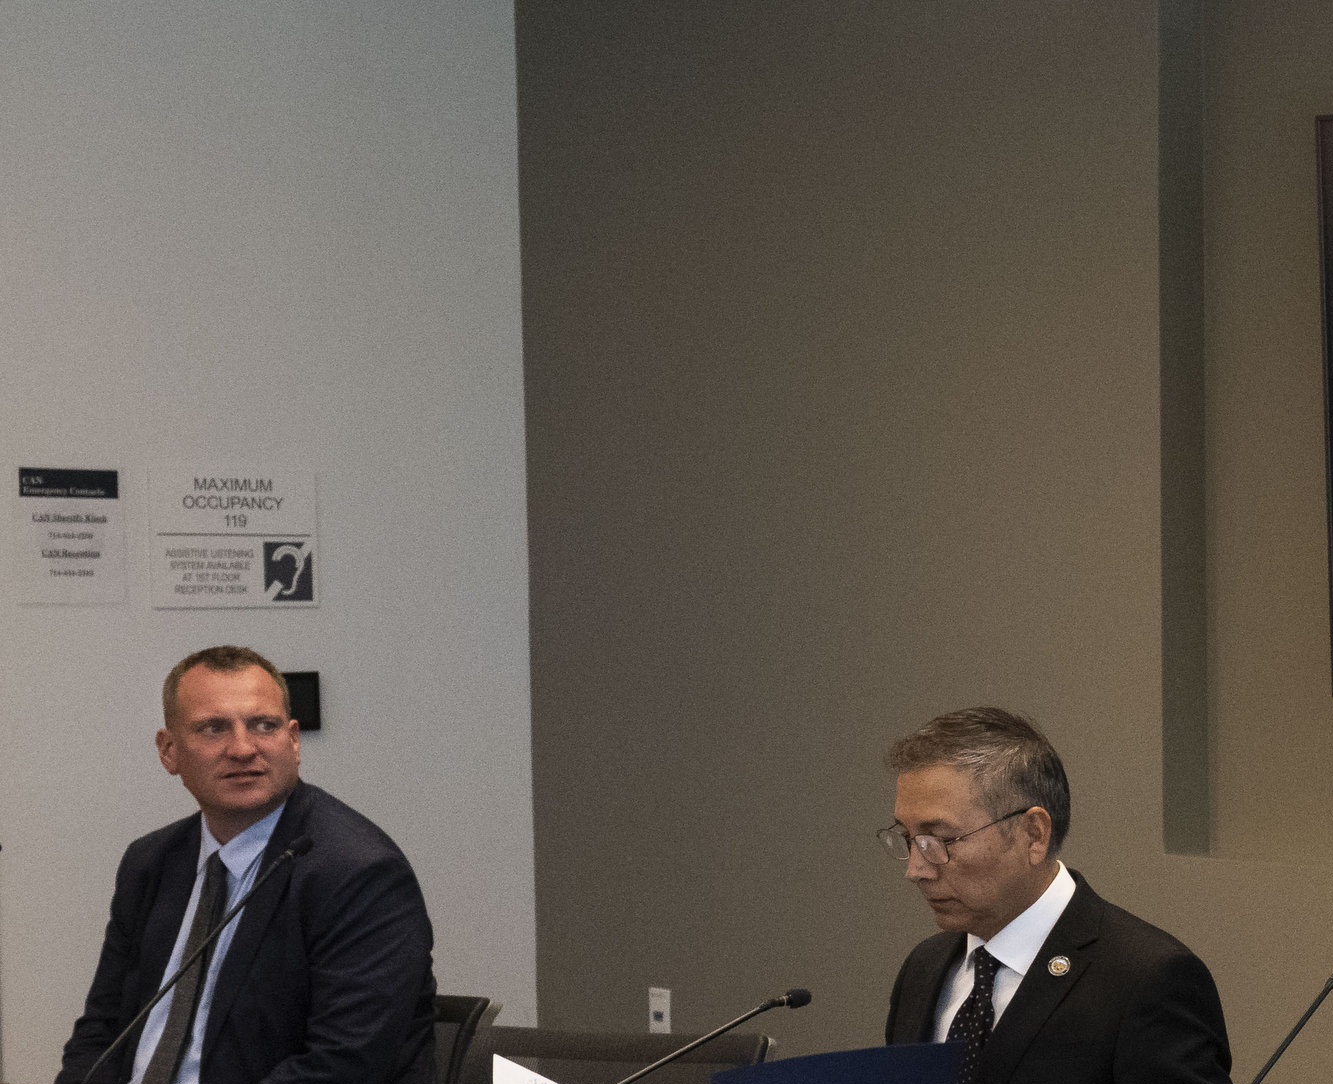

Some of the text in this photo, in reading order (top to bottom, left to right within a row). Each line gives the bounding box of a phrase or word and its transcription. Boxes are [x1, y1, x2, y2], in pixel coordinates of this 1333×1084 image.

[193, 477, 273, 493] MAXIMUM
[182, 495, 284, 511] OCCUPANCY
[223, 513, 247, 528] 119
[170, 561, 251, 571] SYSTEM AVAILABLE
[211, 572, 241, 582] FLOOR
[174, 584, 223, 595] RECEPTION
